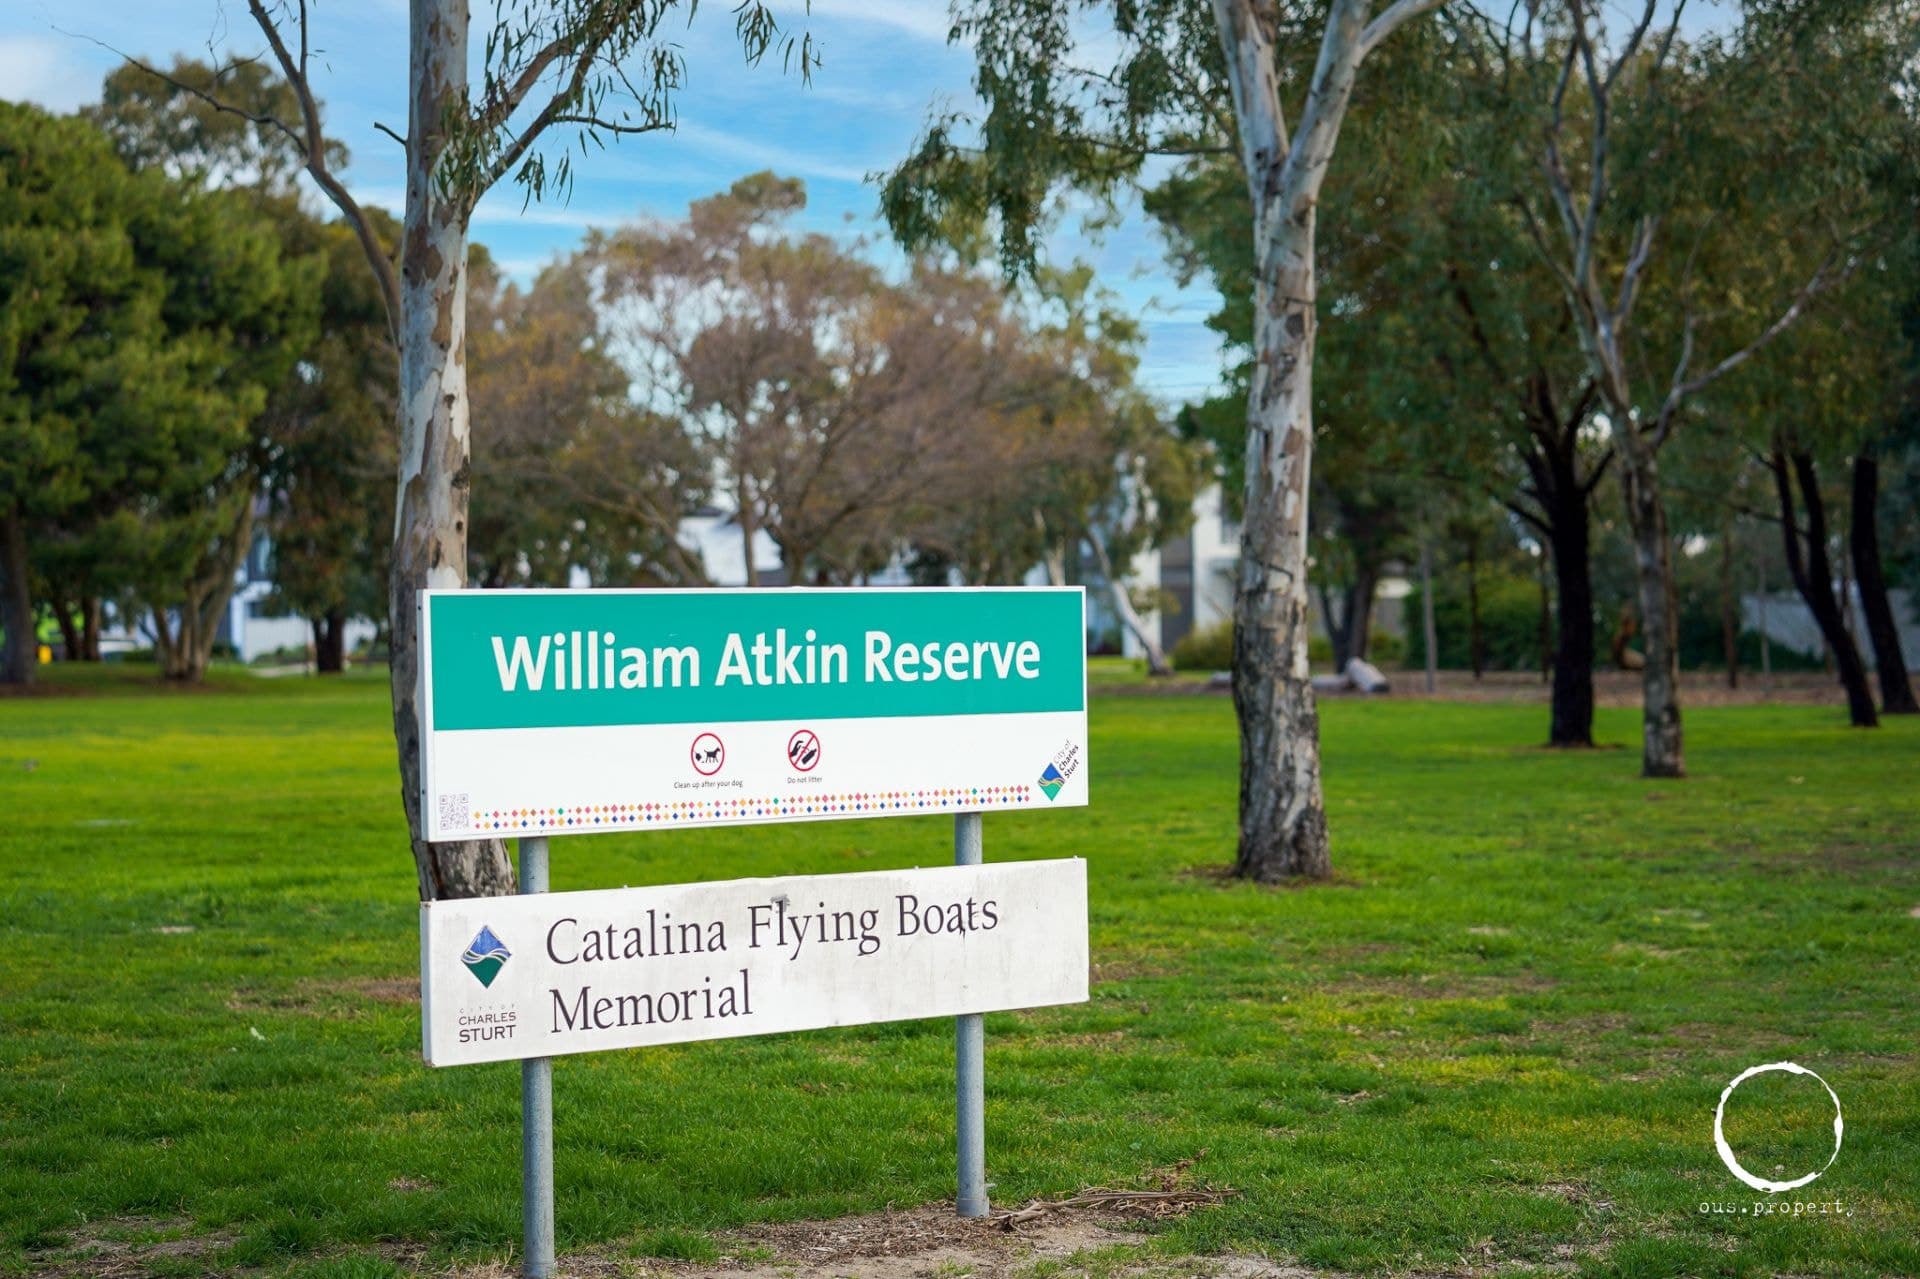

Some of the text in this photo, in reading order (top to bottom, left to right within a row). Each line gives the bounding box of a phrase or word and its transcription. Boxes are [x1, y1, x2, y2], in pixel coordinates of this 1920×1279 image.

[491, 627, 1041, 692] William Atkin Reserve
[1059, 744, 1079, 771] Charles
[1064, 758, 1079, 779] Sturt
[674, 779, 743, 790] Clean up after your dog
[787, 775, 823, 784] Do not litter
[546, 893, 1000, 966] Catalina Flying Boats
[549, 969, 754, 1035] Memorial
[458, 1011, 517, 1025] CHARLES
[459, 1024, 517, 1043] STURT
